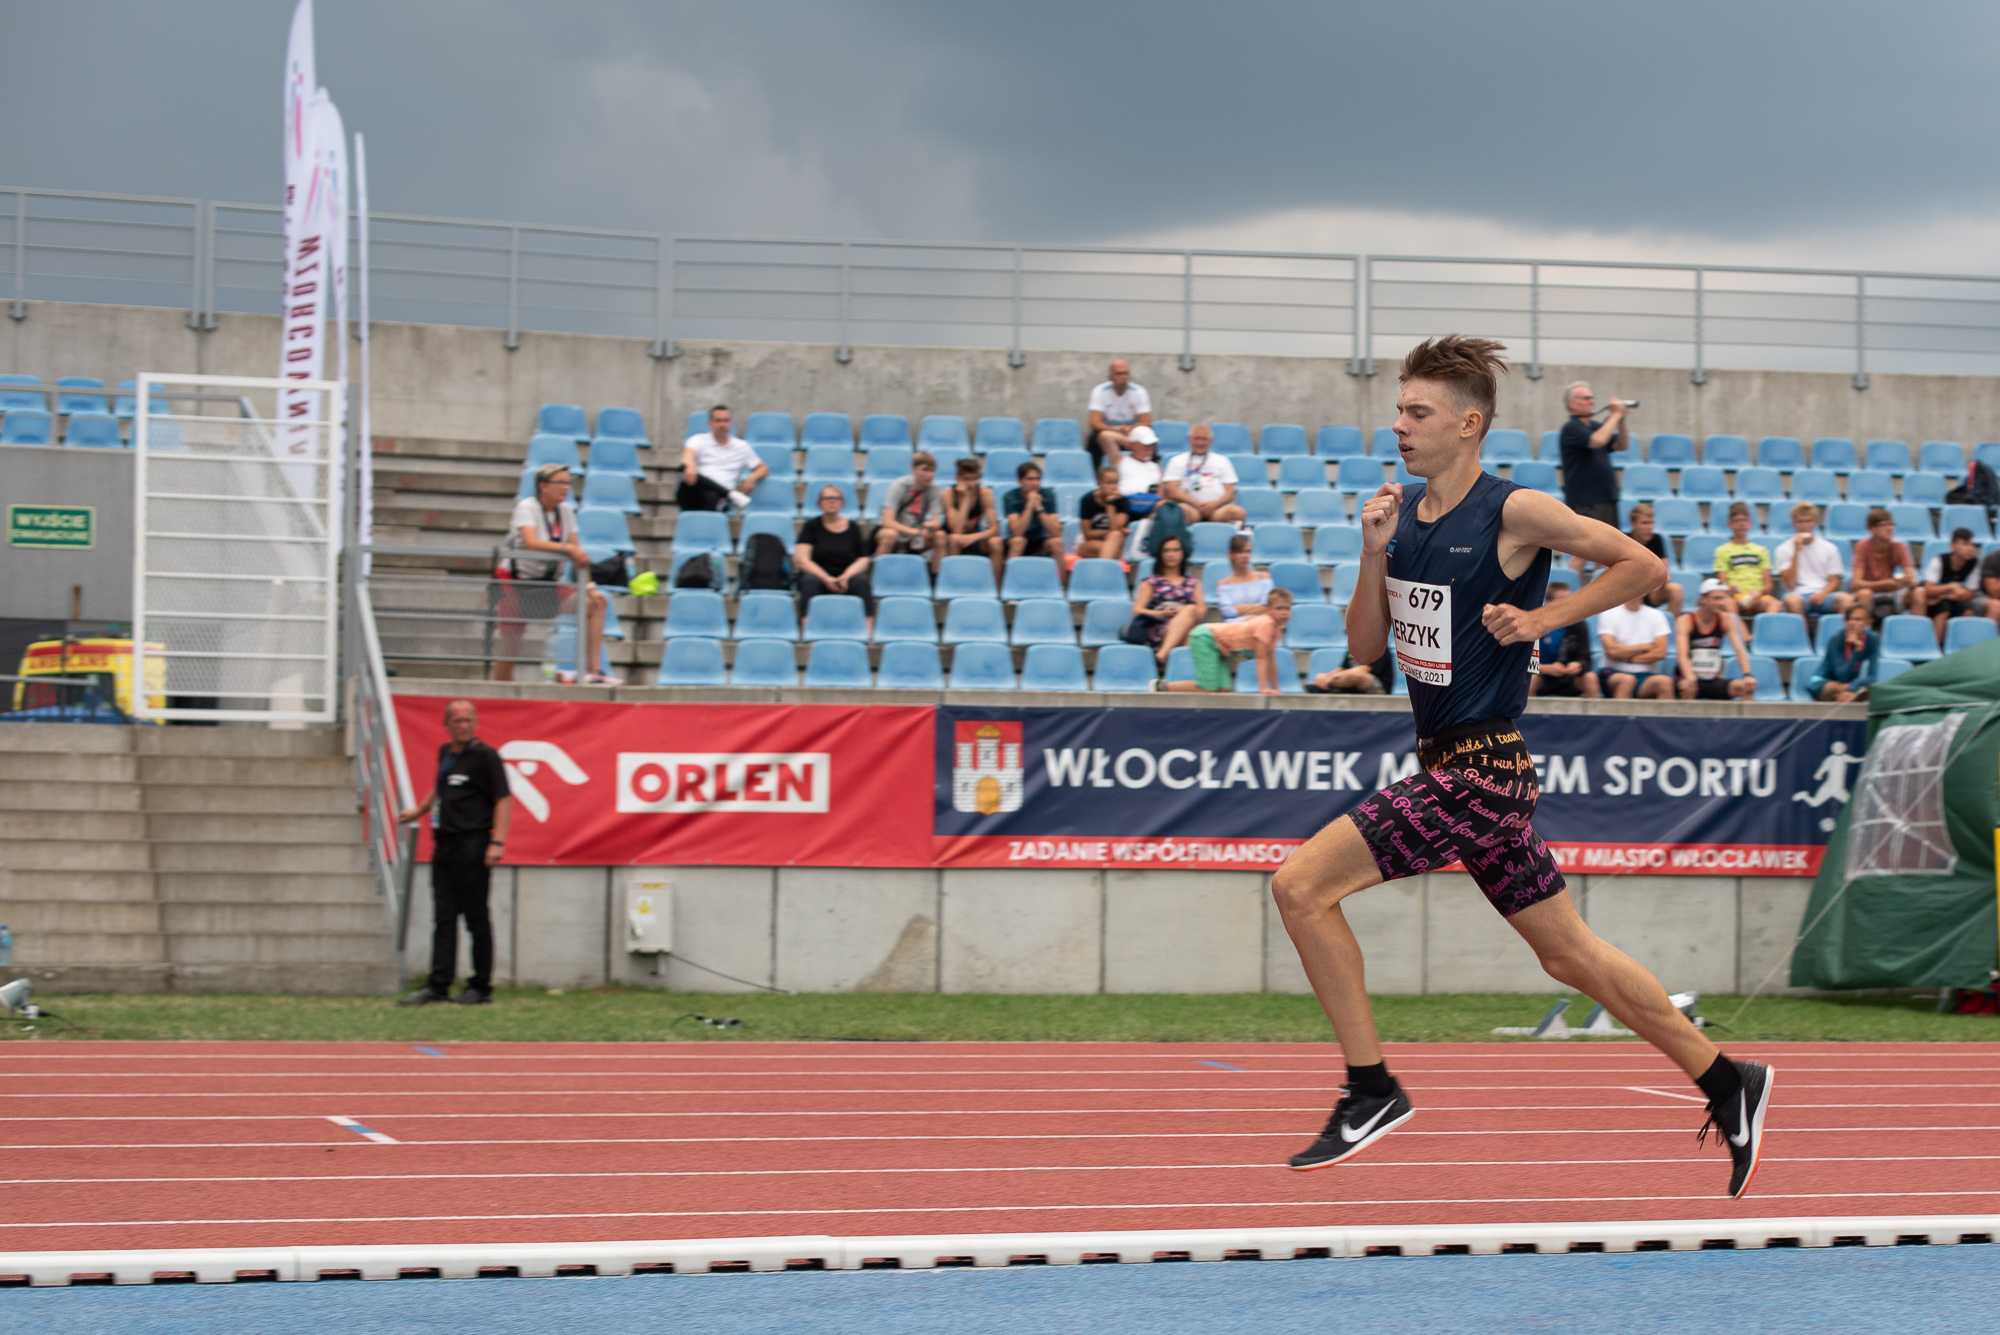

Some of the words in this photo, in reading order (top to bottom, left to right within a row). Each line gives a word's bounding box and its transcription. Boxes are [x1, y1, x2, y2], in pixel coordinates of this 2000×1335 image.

[1409, 587, 1444, 611] 679
[1424, 671, 1444, 683] 2021
[631, 763, 813, 803] ORLEN
[1043, 748, 1363, 790] WŁOCŁAWEK
[1603, 755, 1777, 797] SPORTU
[1392, 796, 1441, 842] Poland
[1009, 841, 1107, 861] ZADANIE
[1583, 848, 1666, 868] MIASTO
[1671, 849, 1808, 869] WŁOCŁAWEK
